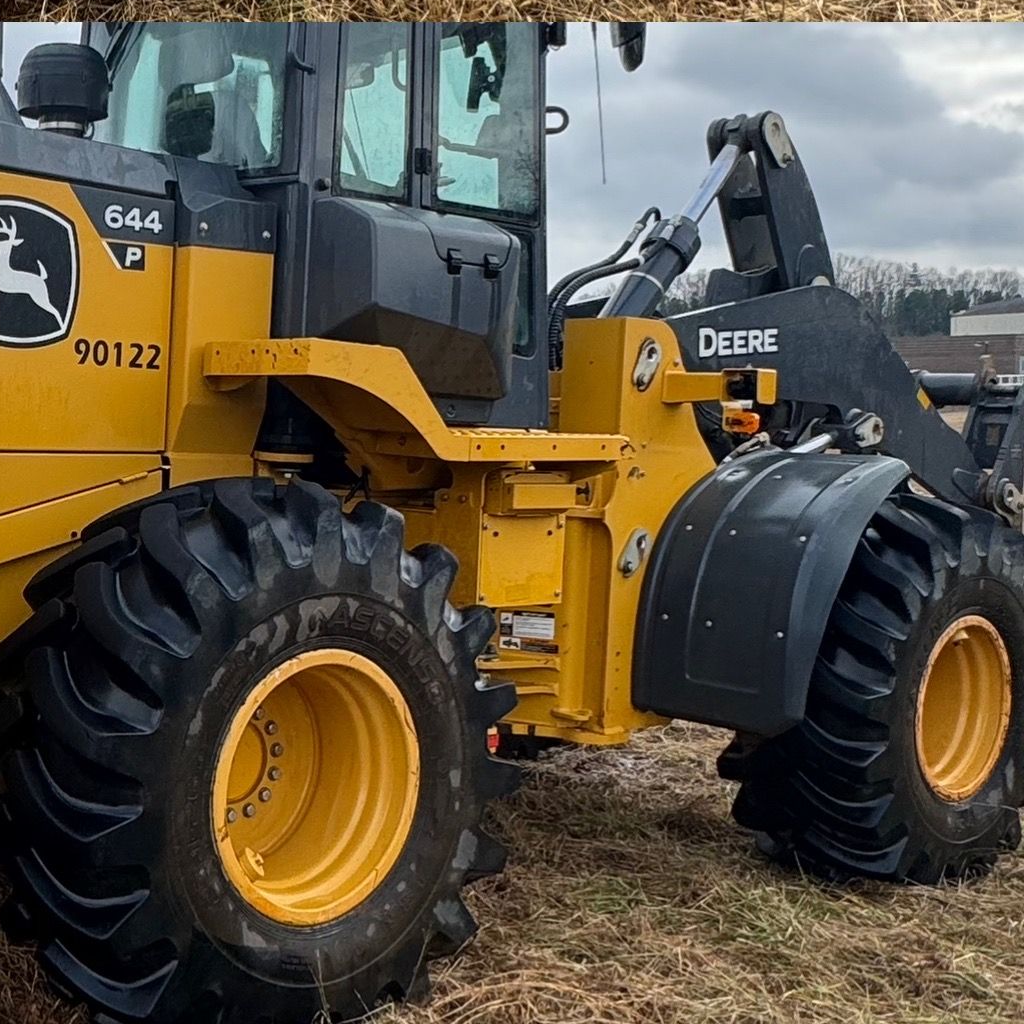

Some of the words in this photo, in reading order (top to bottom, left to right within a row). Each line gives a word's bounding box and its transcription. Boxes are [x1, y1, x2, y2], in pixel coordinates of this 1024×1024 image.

[104, 204, 163, 234] 644
[124, 246, 143, 267] P
[74, 338, 161, 370] 90122
[698, 327, 779, 358] DEERE
